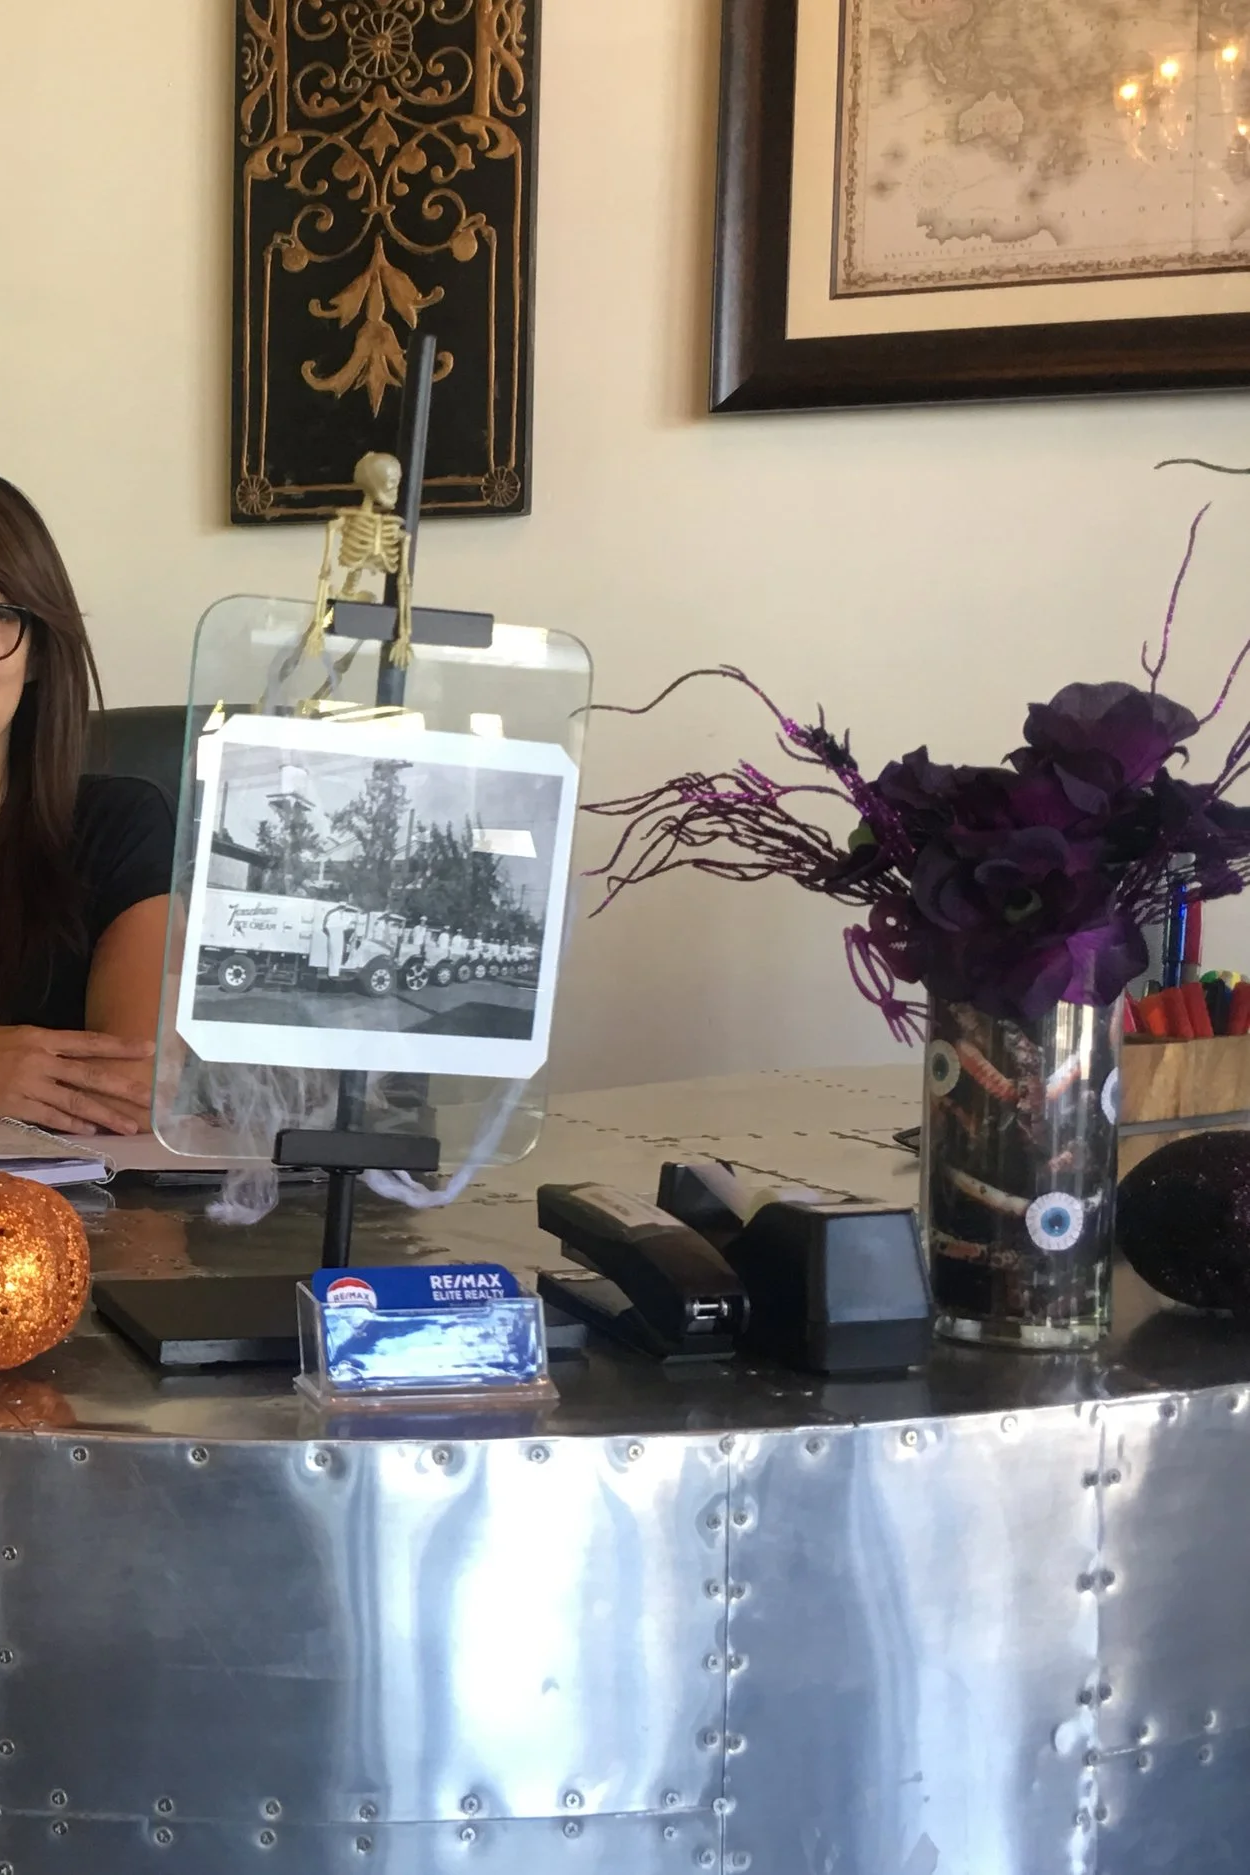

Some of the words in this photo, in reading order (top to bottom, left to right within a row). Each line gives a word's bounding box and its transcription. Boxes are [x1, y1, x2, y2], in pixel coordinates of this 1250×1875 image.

[429, 1273, 502, 1290] RE/MAX
[333, 1290, 370, 1304] RE/MAX
[433, 1290, 463, 1302] ELITE
[464, 1289, 505, 1301] REALTY
